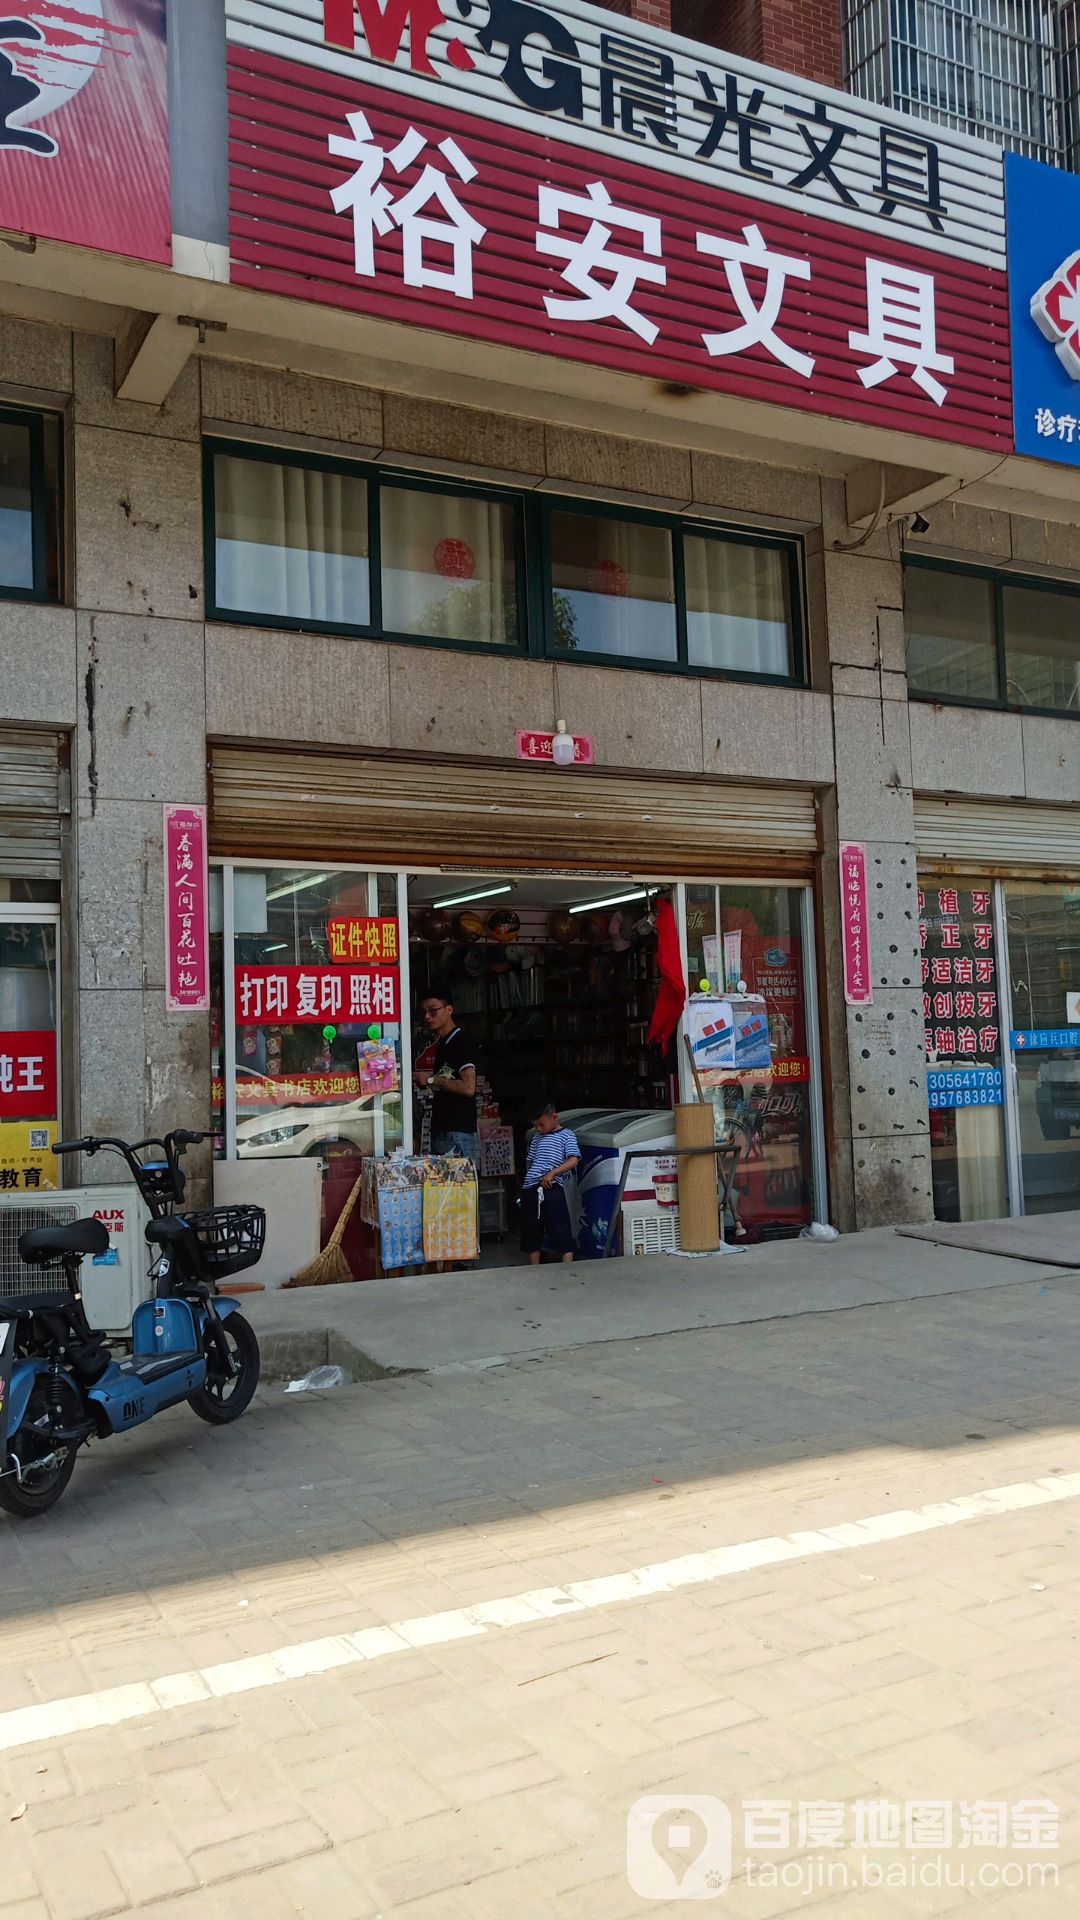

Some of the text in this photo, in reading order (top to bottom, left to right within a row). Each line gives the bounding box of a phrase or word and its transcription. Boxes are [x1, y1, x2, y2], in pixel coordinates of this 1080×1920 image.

[601, 33, 948, 232] 晨光文具
[328, 111, 955, 407] 裕安文具
[1034, 407, 1080, 443] 诊疗
[526, 736, 584, 758] 喜迎春
[331, 922, 397, 958] 证件快照
[240, 973, 394, 1017] 打印 复印 照相
[927, 1071, 1002, 1089] 305641780
[928, 1088, 1002, 1106] 957683821
[0, 1167, 43, 1189] 教育
[92, 1210, 125, 1220] AUX
